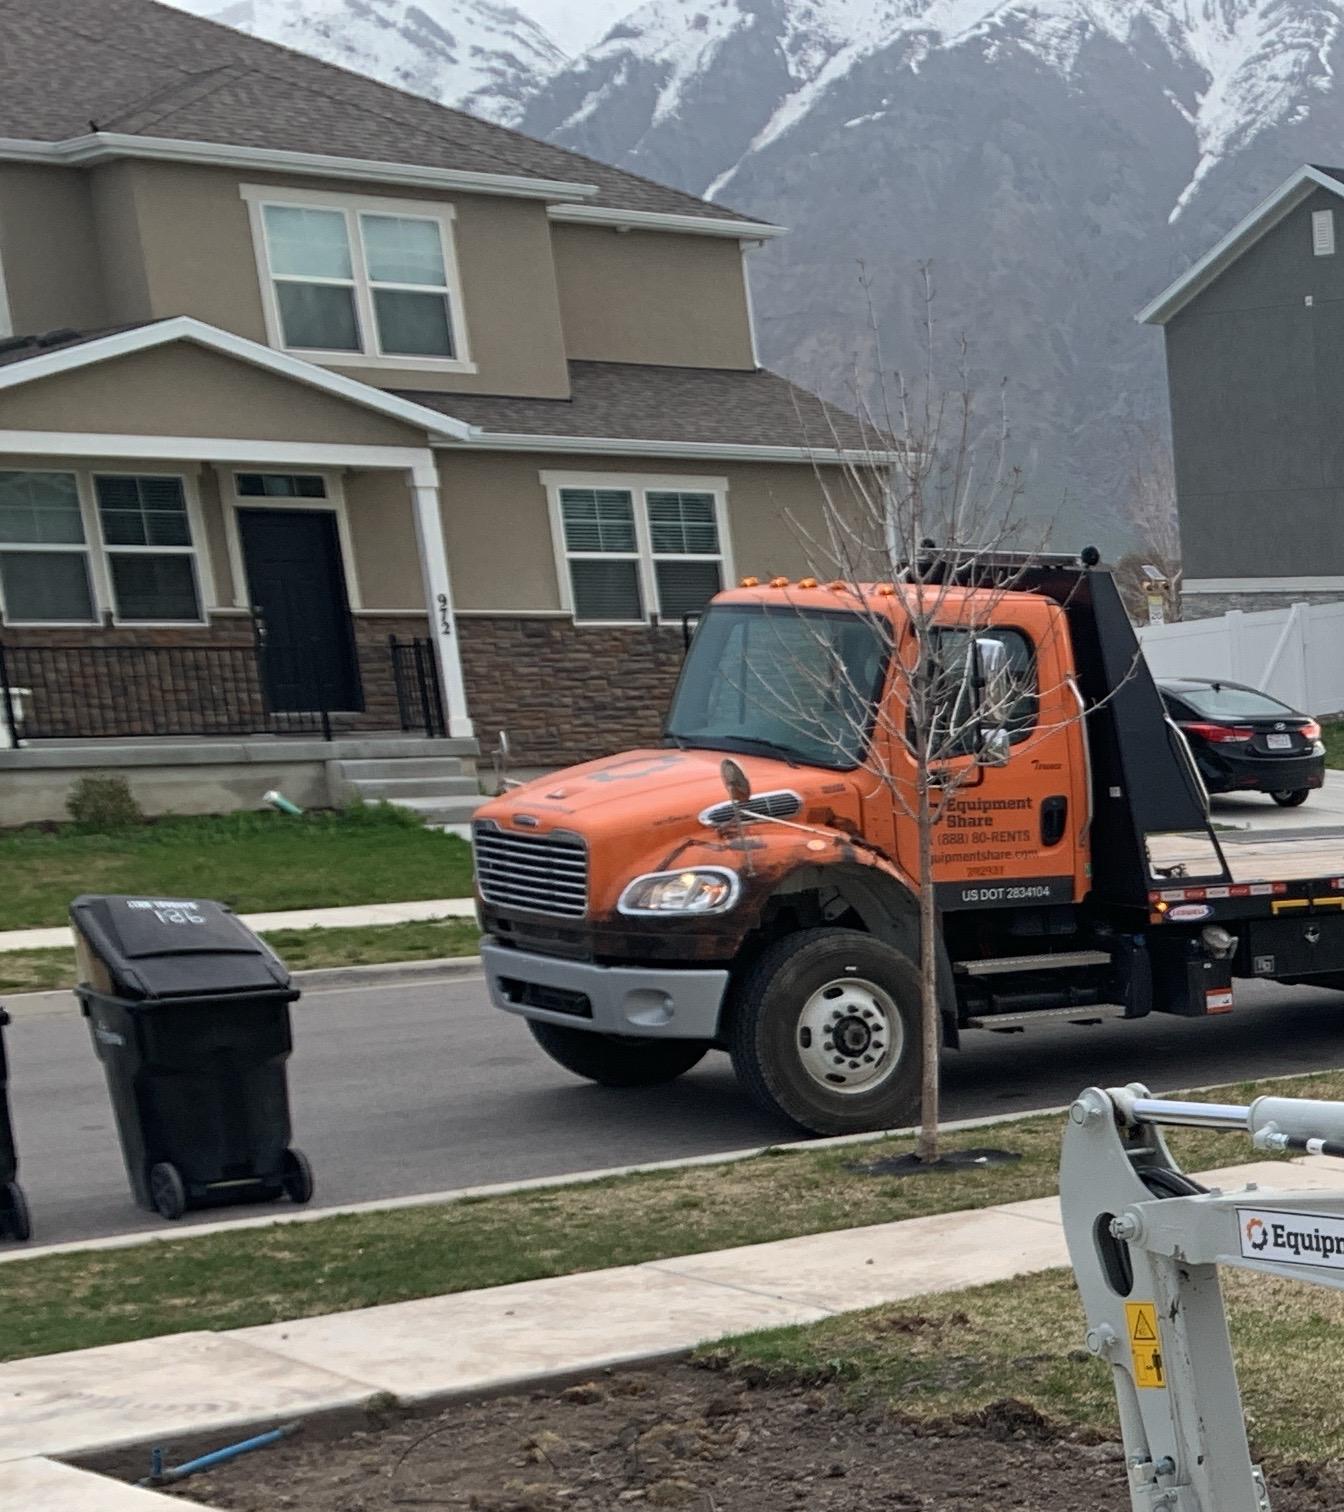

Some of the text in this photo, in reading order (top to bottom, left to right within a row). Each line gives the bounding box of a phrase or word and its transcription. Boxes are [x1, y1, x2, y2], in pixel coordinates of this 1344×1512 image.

[945, 797, 1032, 813] Equipment
[946, 814, 993, 828] Share
[971, 830, 1031, 845] 80-RENTS
[962, 889, 978, 901] US
[980, 888, 1004, 900] DOT
